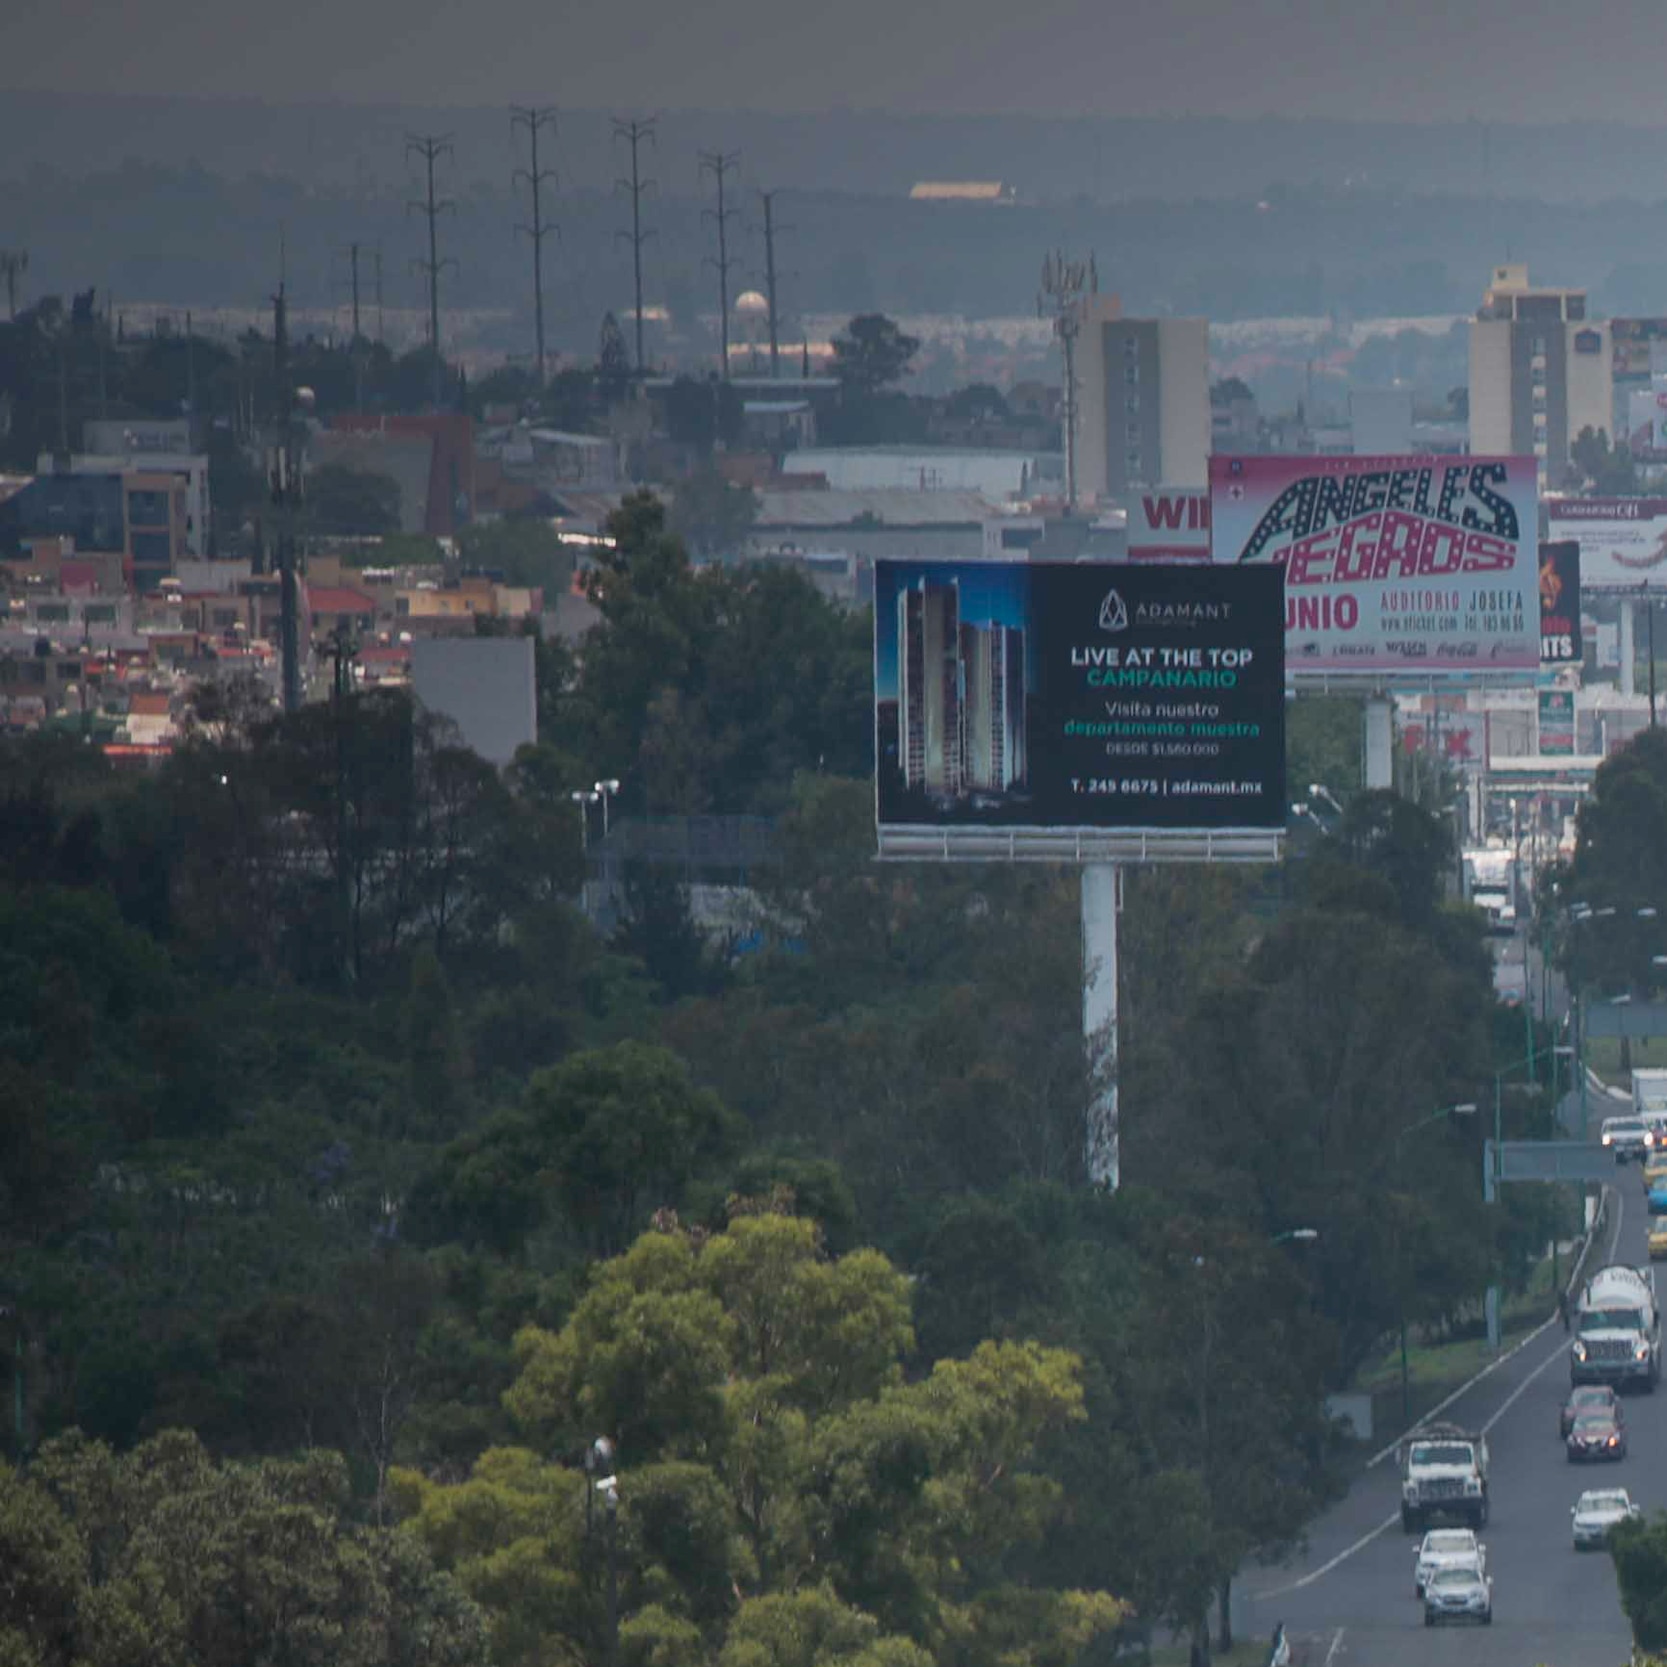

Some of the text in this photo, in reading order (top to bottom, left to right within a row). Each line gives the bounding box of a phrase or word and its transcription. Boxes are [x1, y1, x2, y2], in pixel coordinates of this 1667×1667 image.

[1239, 462, 1520, 566] ANGELES
[1273, 510, 1518, 586] EGROS
[1136, 603, 1232, 618] ADAMANT
[1380, 590, 1524, 612] AUDITORIO JOSEFA
[1540, 634, 1573, 658] ITS
[1070, 648, 1253, 668] LIVE AT THE TOP
[1086, 668, 1237, 688] CAMPANARIO
[1104, 701, 1220, 718] Visita nuestro
[1063, 720, 1260, 738] departamento muestra
[1171, 780, 1263, 795] adamant.mx
